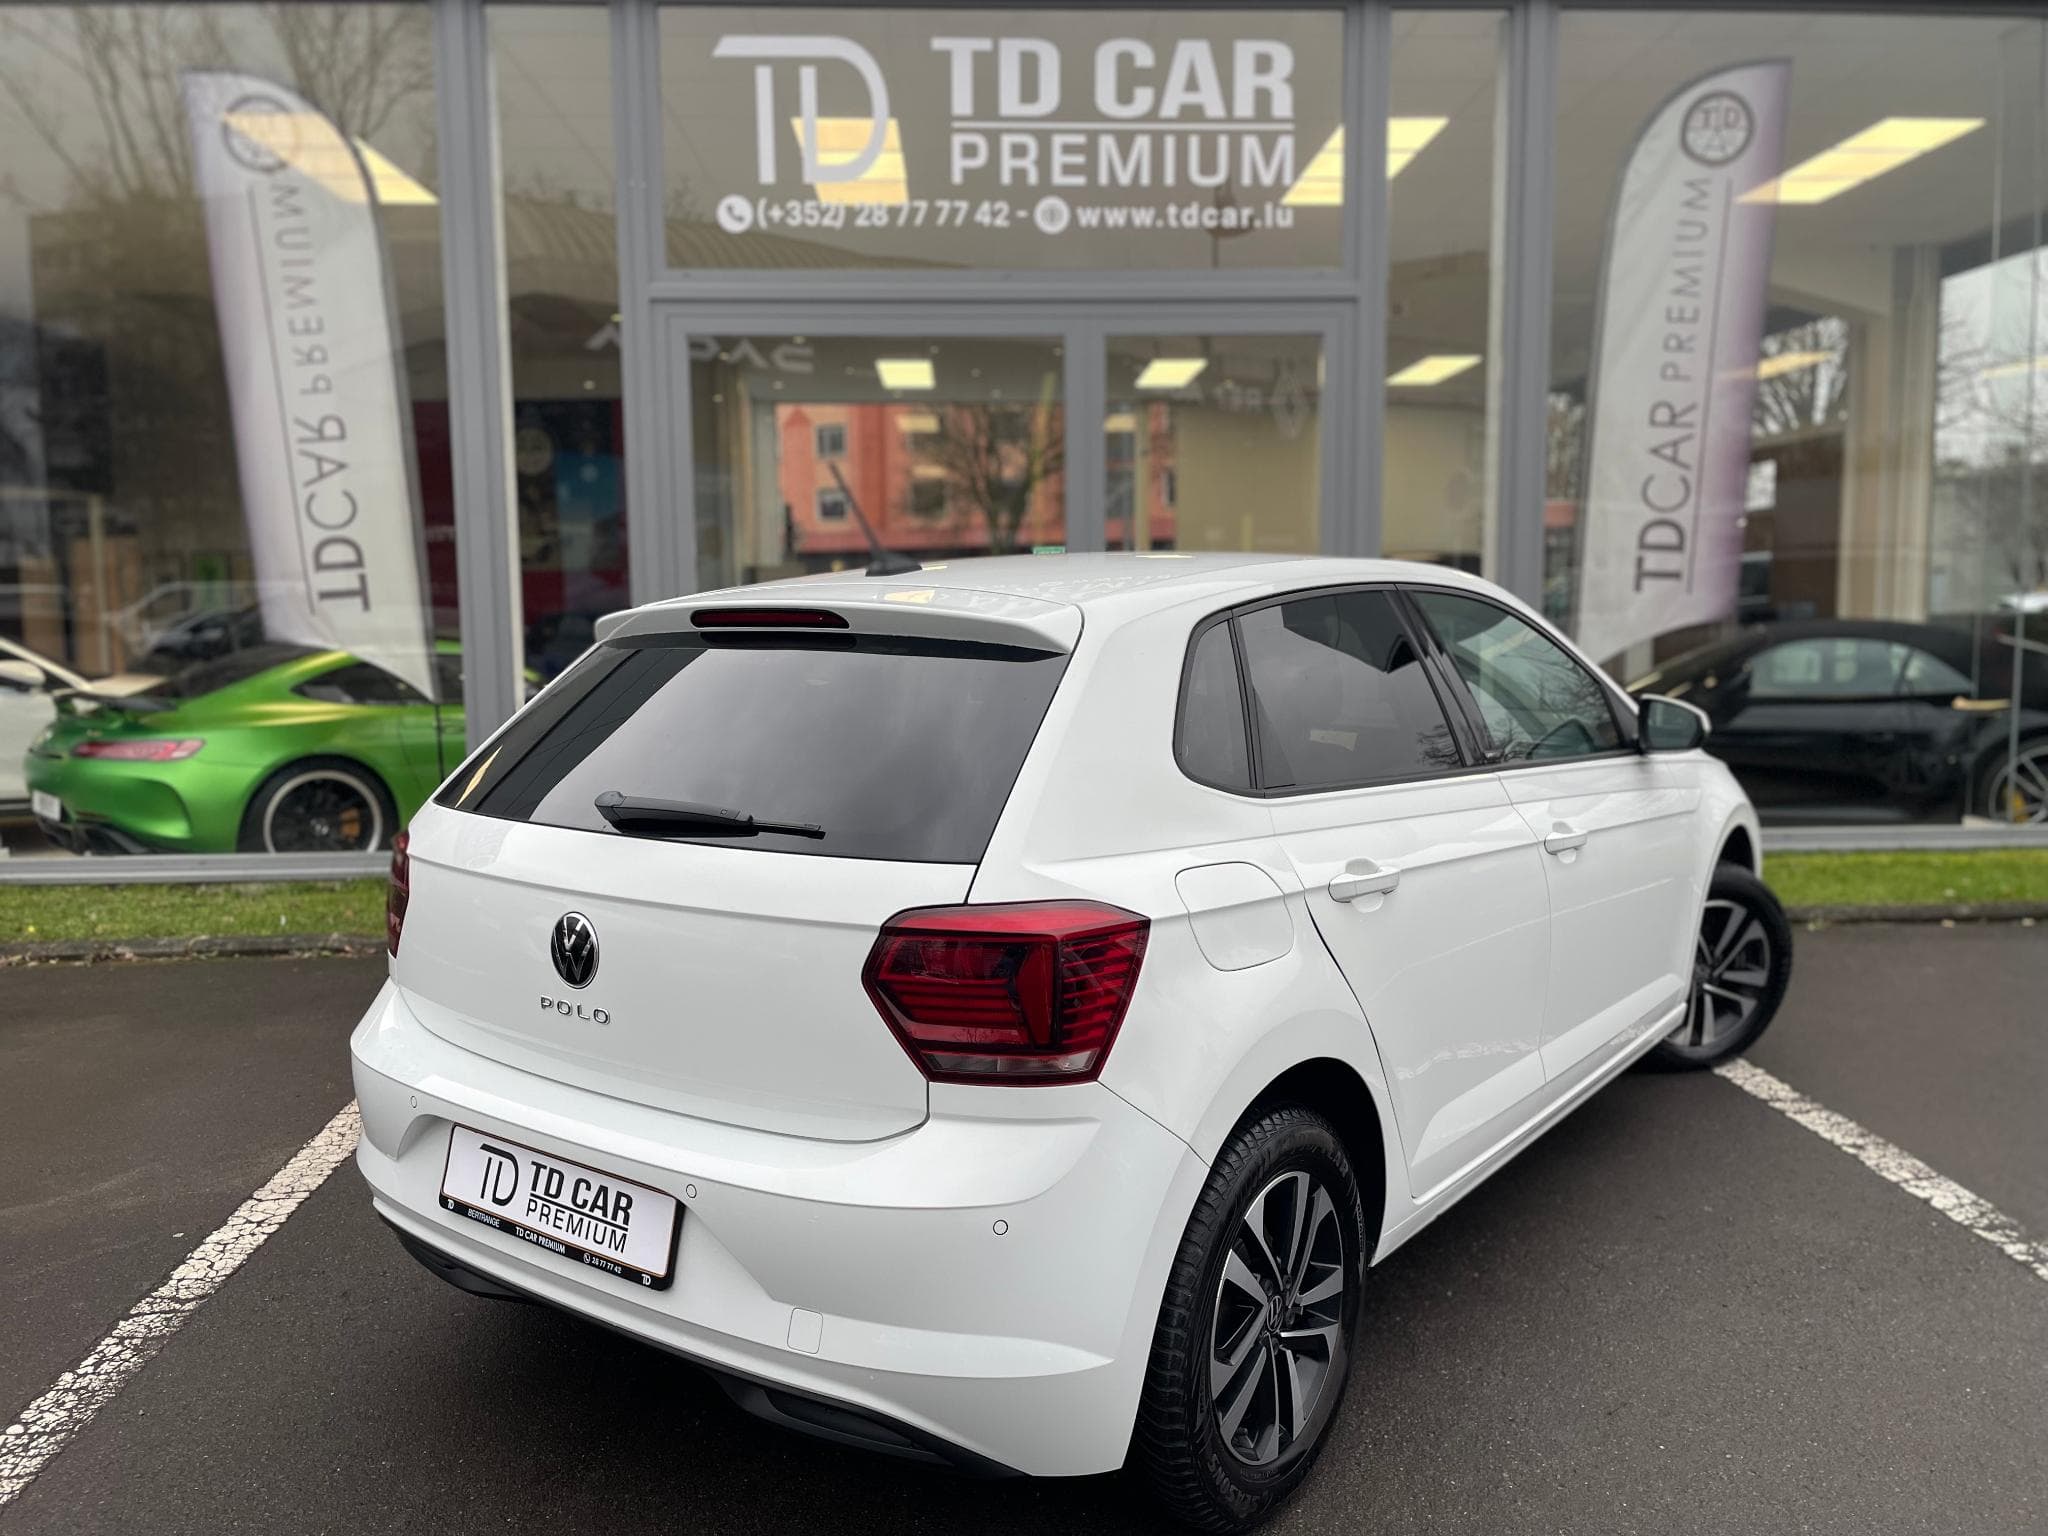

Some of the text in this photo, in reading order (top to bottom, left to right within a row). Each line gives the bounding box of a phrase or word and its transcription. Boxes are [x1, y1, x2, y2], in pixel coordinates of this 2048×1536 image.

[931, 37, 1295, 118] TD CAR
[950, 133, 1295, 187] PREMIUM
[757, 197, 845, 230] (+352)
[855, 201, 889, 227] 28
[896, 201, 928, 227] 77
[936, 201, 968, 227] 77
[973, 201, 1011, 228] 42
[1076, 201, 1295, 229] www.tdcar.lu
[1633, 177, 1713, 596] TDCAR PREMIUM
[540, 994, 611, 1025] POLO
[467, 1208, 501, 1228] BERTRANGE
[530, 1161, 633, 1226] TD CAR
[515, 1226, 566, 1255] TD CAR PREMIUM
[526, 1198, 628, 1254] PREMIUM
